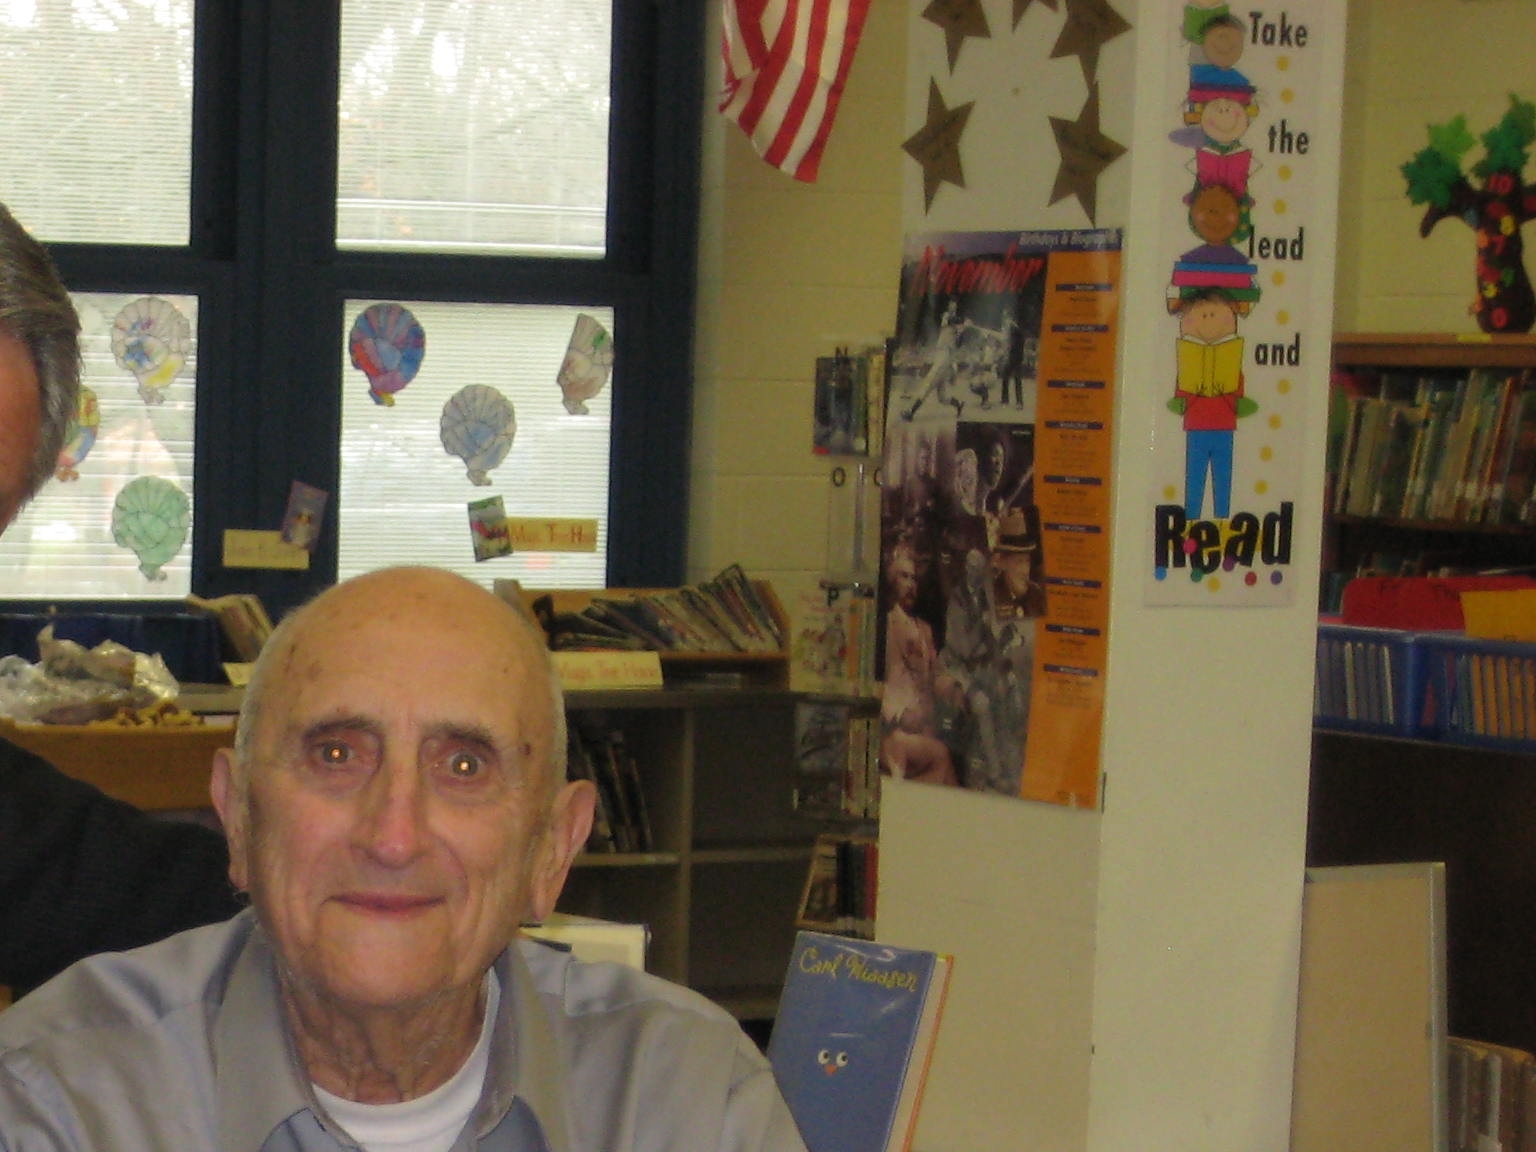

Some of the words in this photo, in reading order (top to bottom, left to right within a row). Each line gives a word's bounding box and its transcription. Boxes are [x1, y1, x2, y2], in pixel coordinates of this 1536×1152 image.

[1248, 10, 1308, 48] Take
[1267, 119, 1310, 156] the
[1248, 225, 1305, 261] lead
[1254, 331, 1301, 367] and
[1154, 501, 1294, 575] Read
